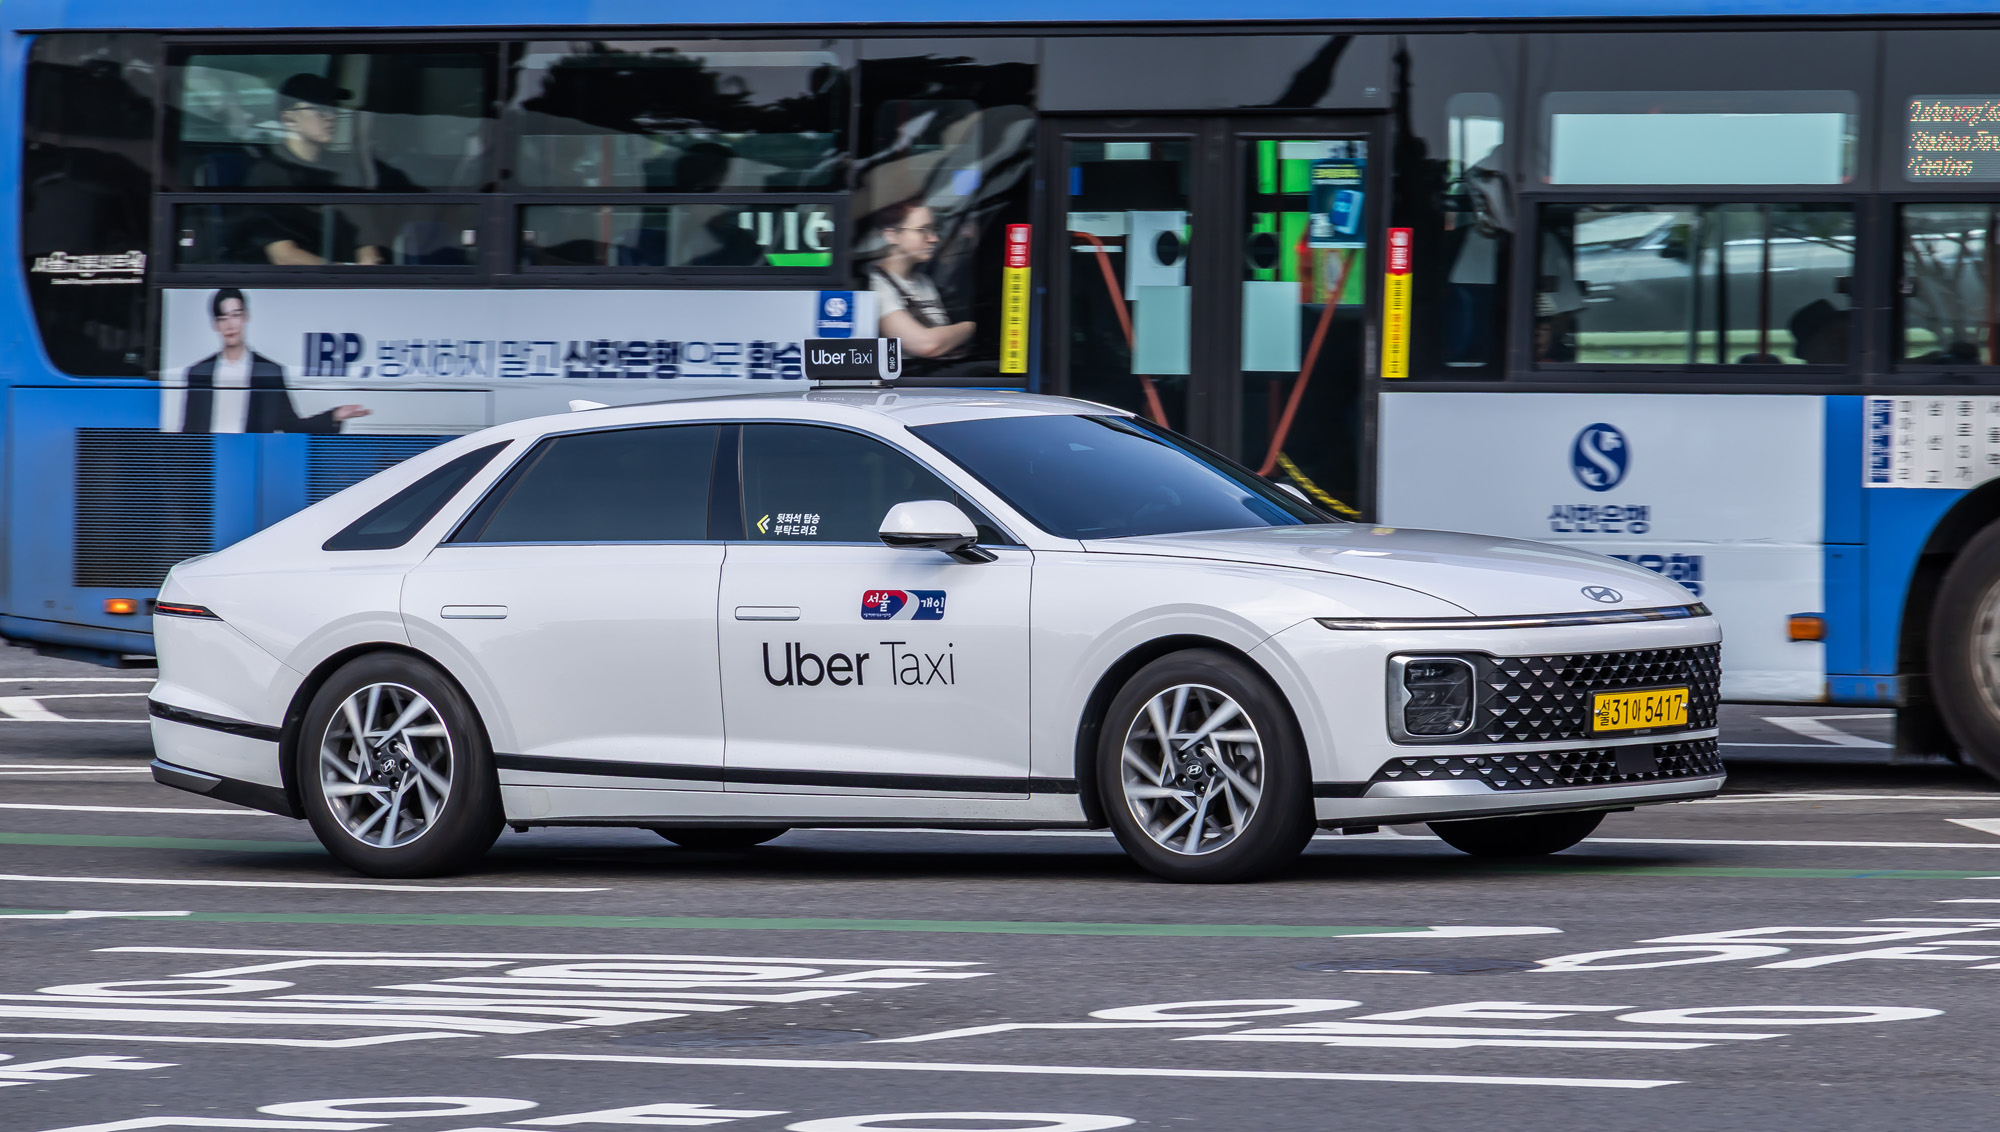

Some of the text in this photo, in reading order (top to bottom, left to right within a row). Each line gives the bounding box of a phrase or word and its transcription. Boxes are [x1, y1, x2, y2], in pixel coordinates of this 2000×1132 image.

[811, 348, 873, 365] Uber Taxi
[776, 513, 821, 524] 뒷좌석 탑승
[1548, 504, 1651, 535] 신한은행
[774, 525, 818, 536] 부탁드려요
[866, 592, 891, 612] 서울
[920, 596, 945, 614] 개인
[762, 641, 956, 687] Uber Taxi
[1645, 694, 1683, 723] 5417
